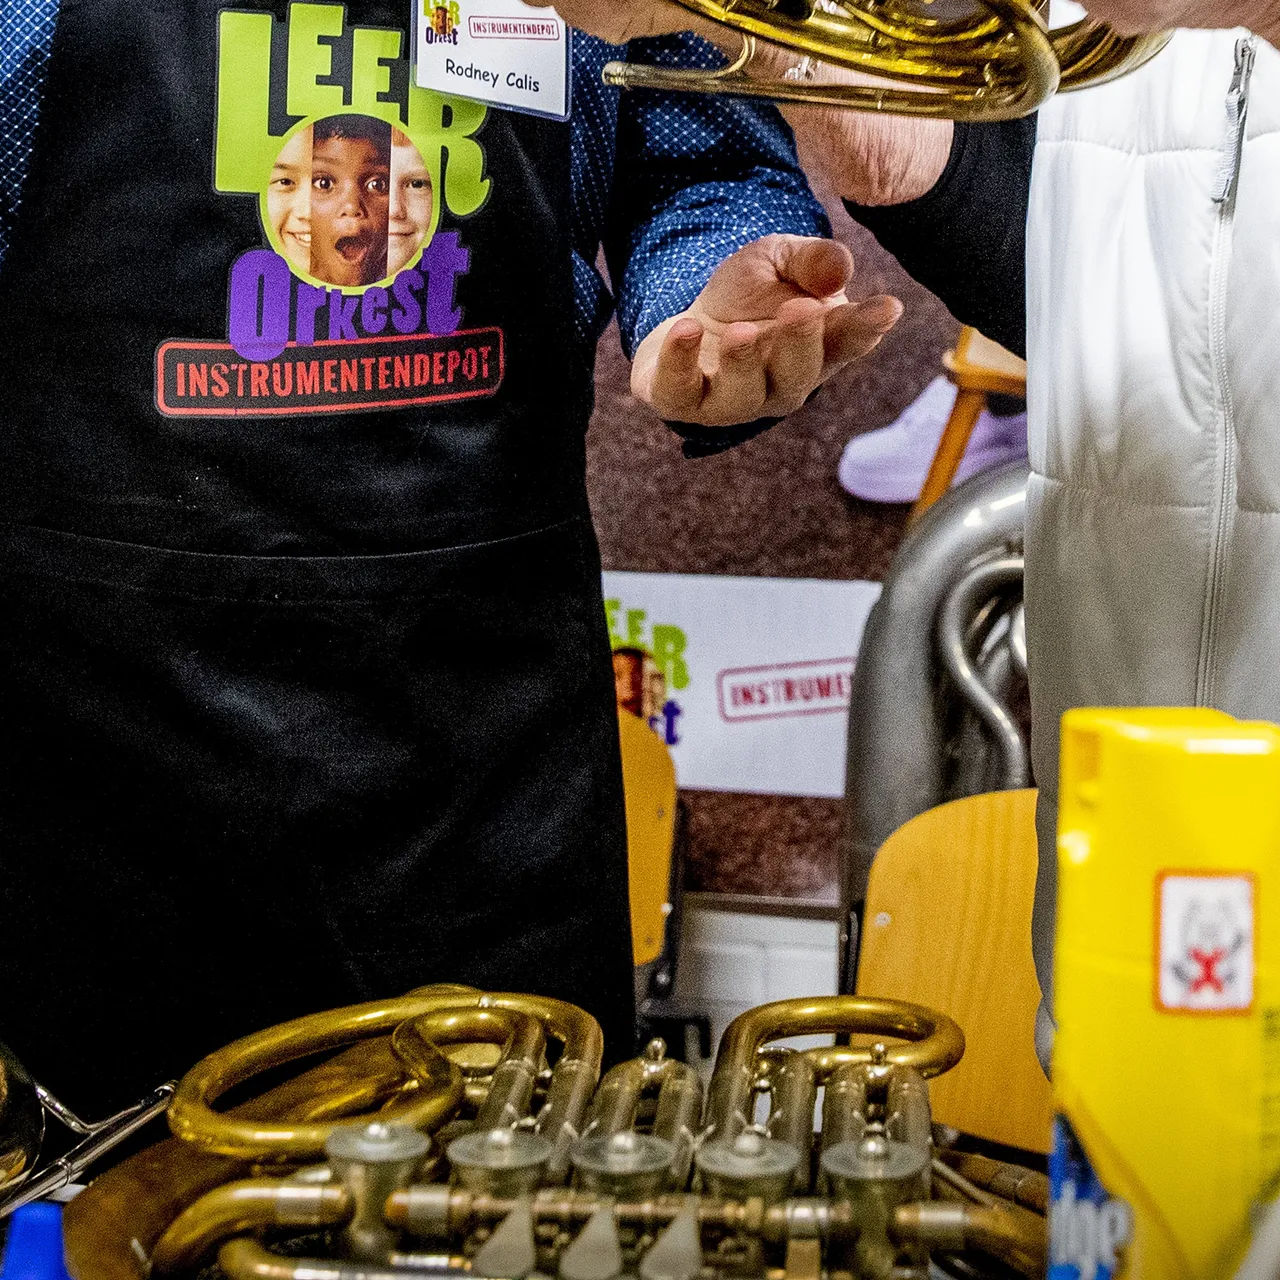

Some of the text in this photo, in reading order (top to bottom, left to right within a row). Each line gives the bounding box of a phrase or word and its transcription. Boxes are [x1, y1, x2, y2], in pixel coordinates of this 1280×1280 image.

[425, 25, 459, 45] Orkest
[472, 21, 557, 36] INSTRUMENTENDEPOT
[445, 57, 541, 93] Rodney Calis
[216, 2, 492, 216] LEER
[229, 231, 470, 361] Orkest
[176, 345, 492, 398] INSTRUMENTENDEPOT
[603, 598, 690, 690] EER
